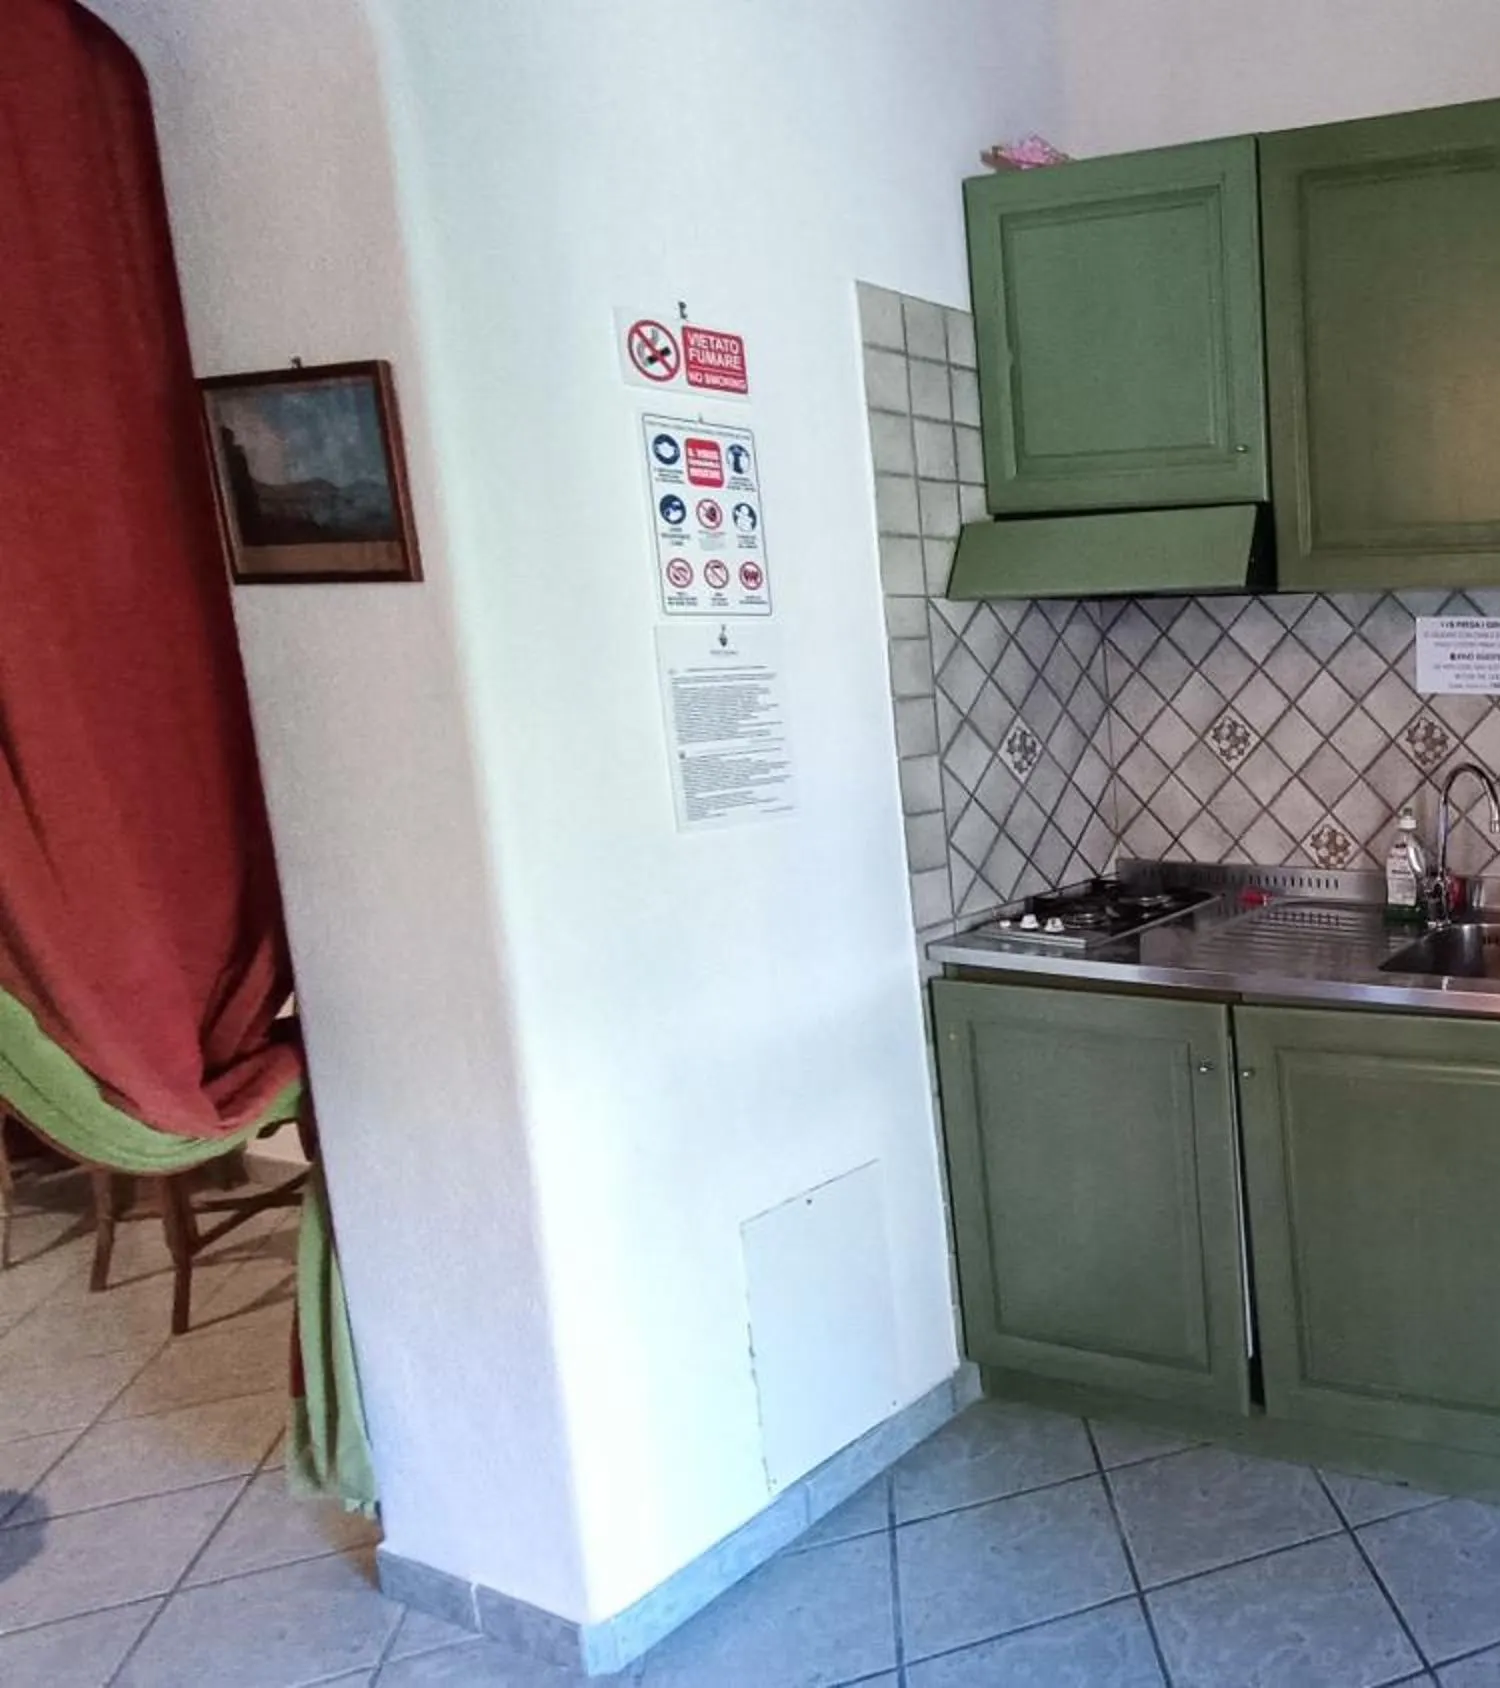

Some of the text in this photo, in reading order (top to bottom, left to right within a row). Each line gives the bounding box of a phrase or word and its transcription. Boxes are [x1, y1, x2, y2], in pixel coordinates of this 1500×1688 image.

[688, 332, 739, 355] VIETATO
[689, 348, 744, 370] FUMARE
[689, 371, 746, 389] NO SMOKING
